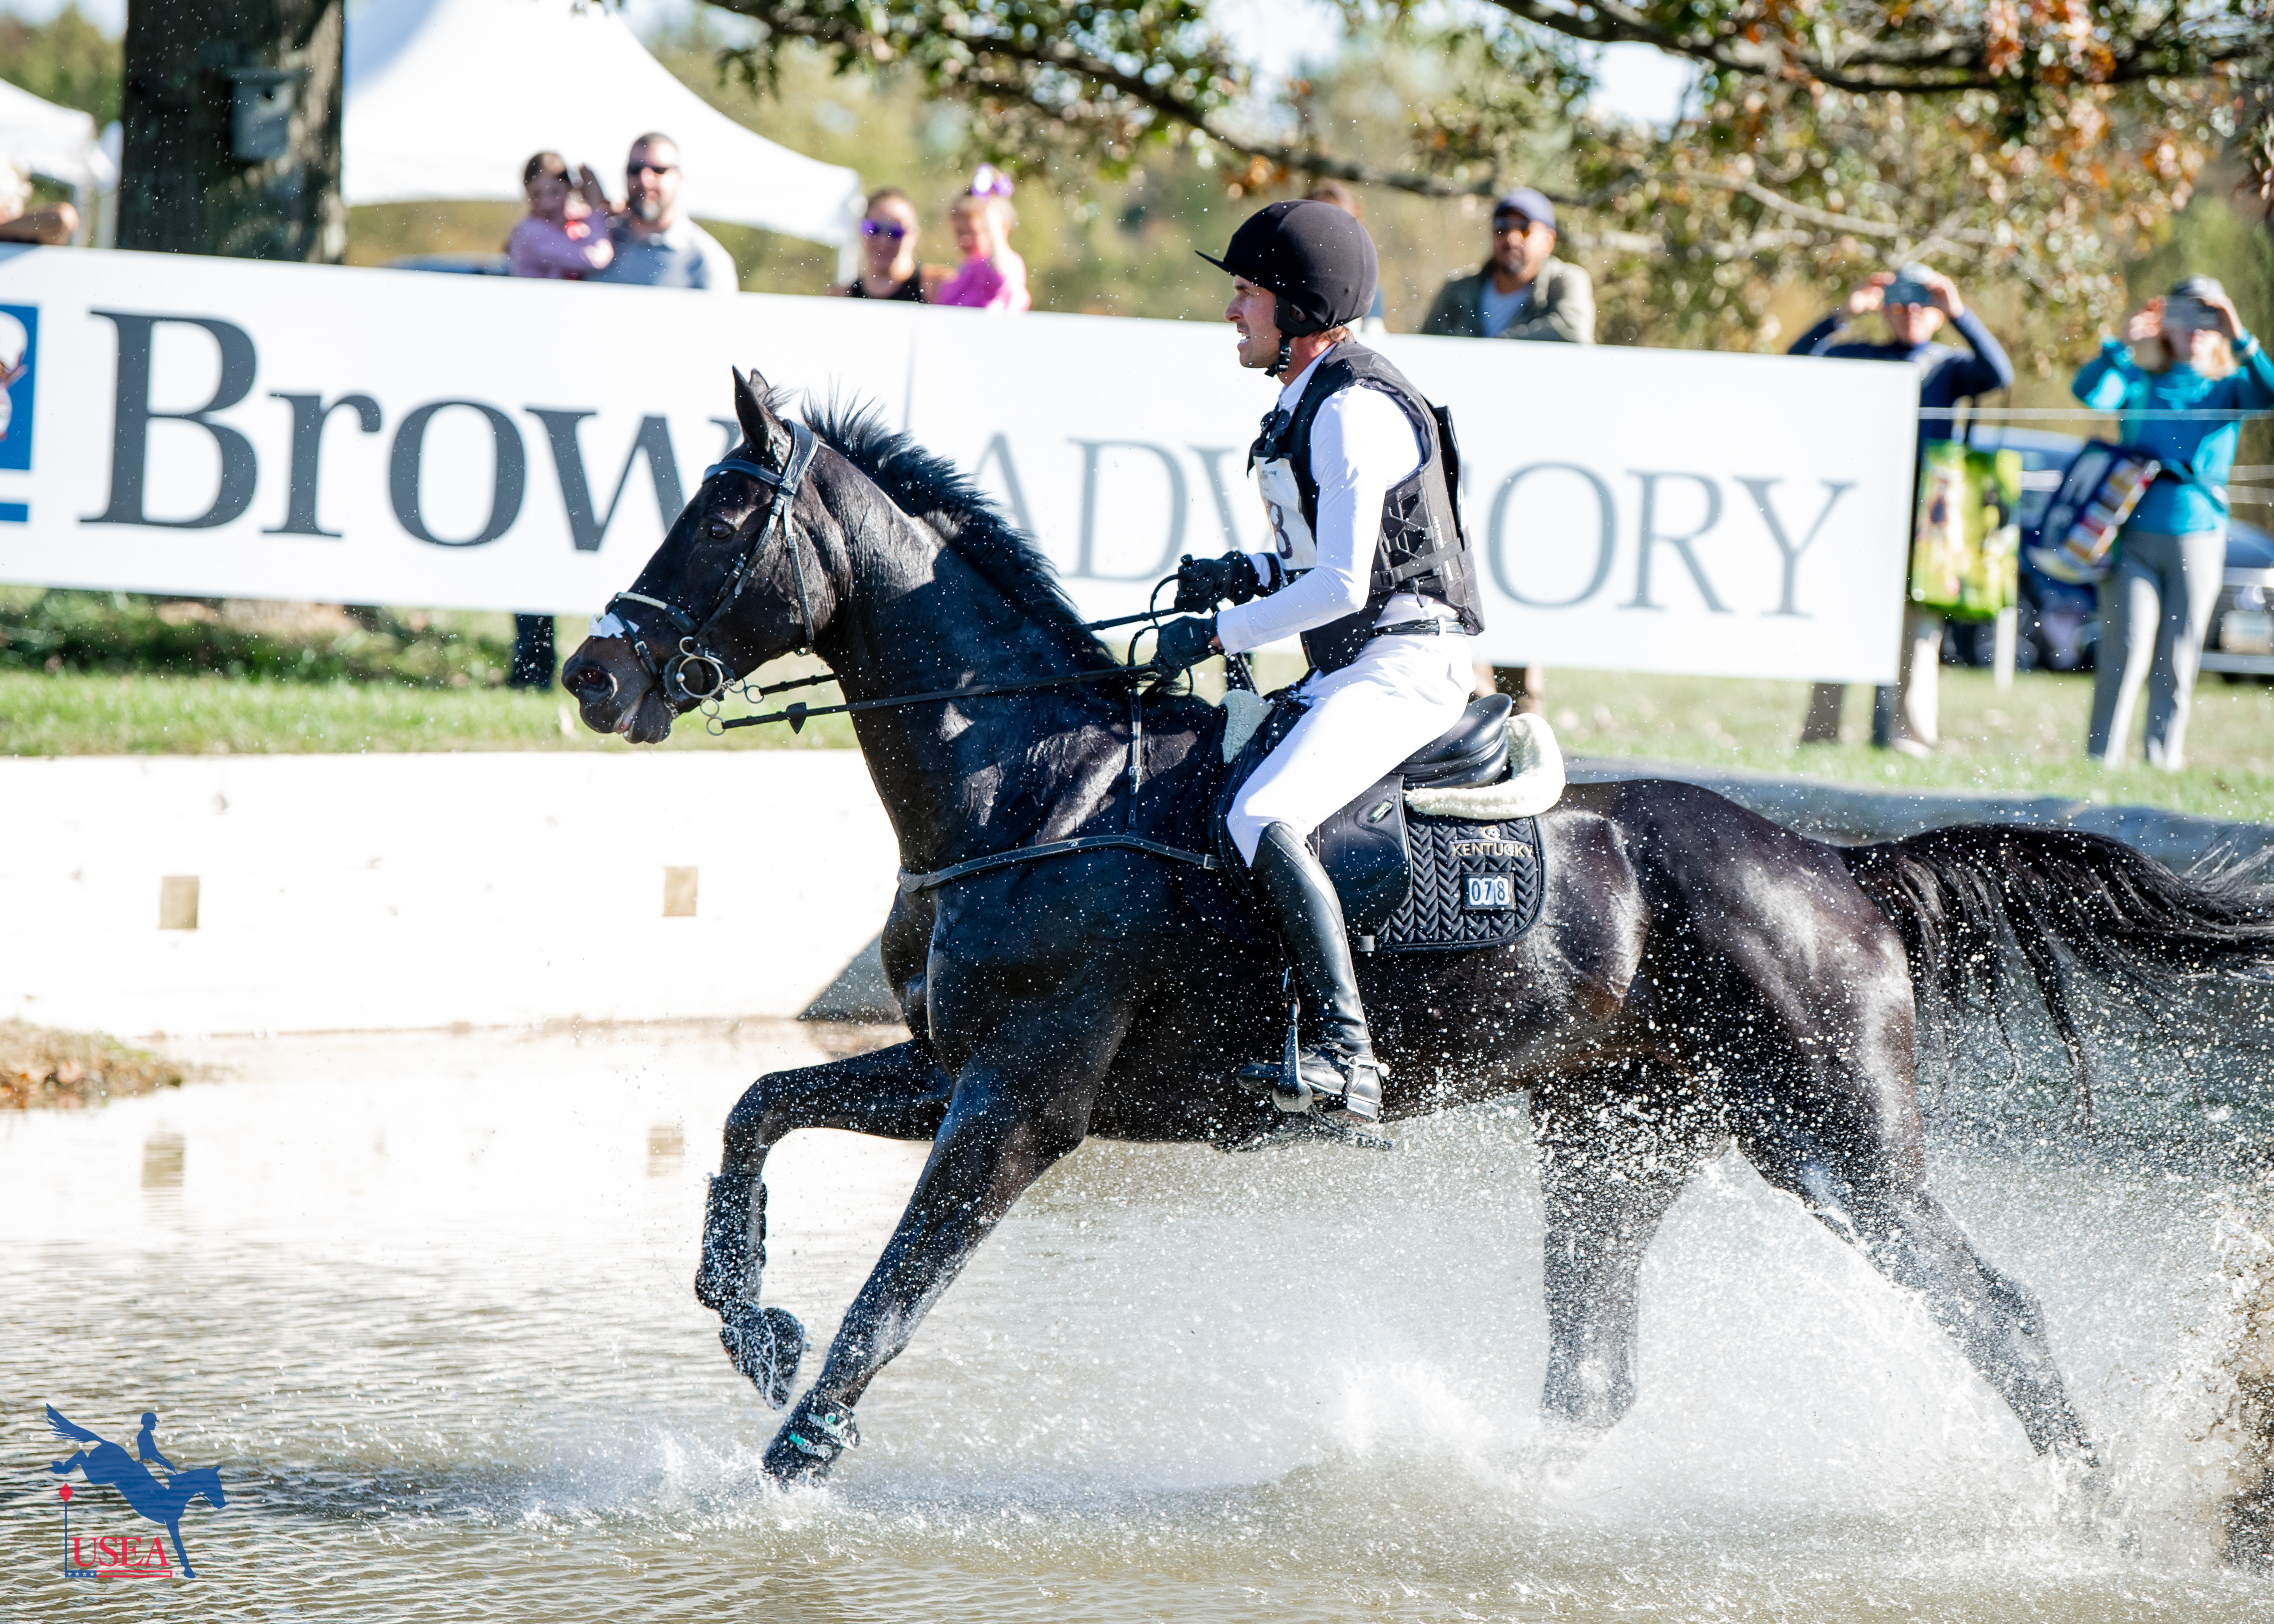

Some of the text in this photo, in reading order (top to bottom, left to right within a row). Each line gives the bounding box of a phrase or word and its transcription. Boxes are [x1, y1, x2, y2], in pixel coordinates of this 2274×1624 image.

[79, 307, 1859, 619] Brow ADVORY
[1452, 842, 1534, 858] KENTUCKY
[1471, 880, 1506, 902] 078
